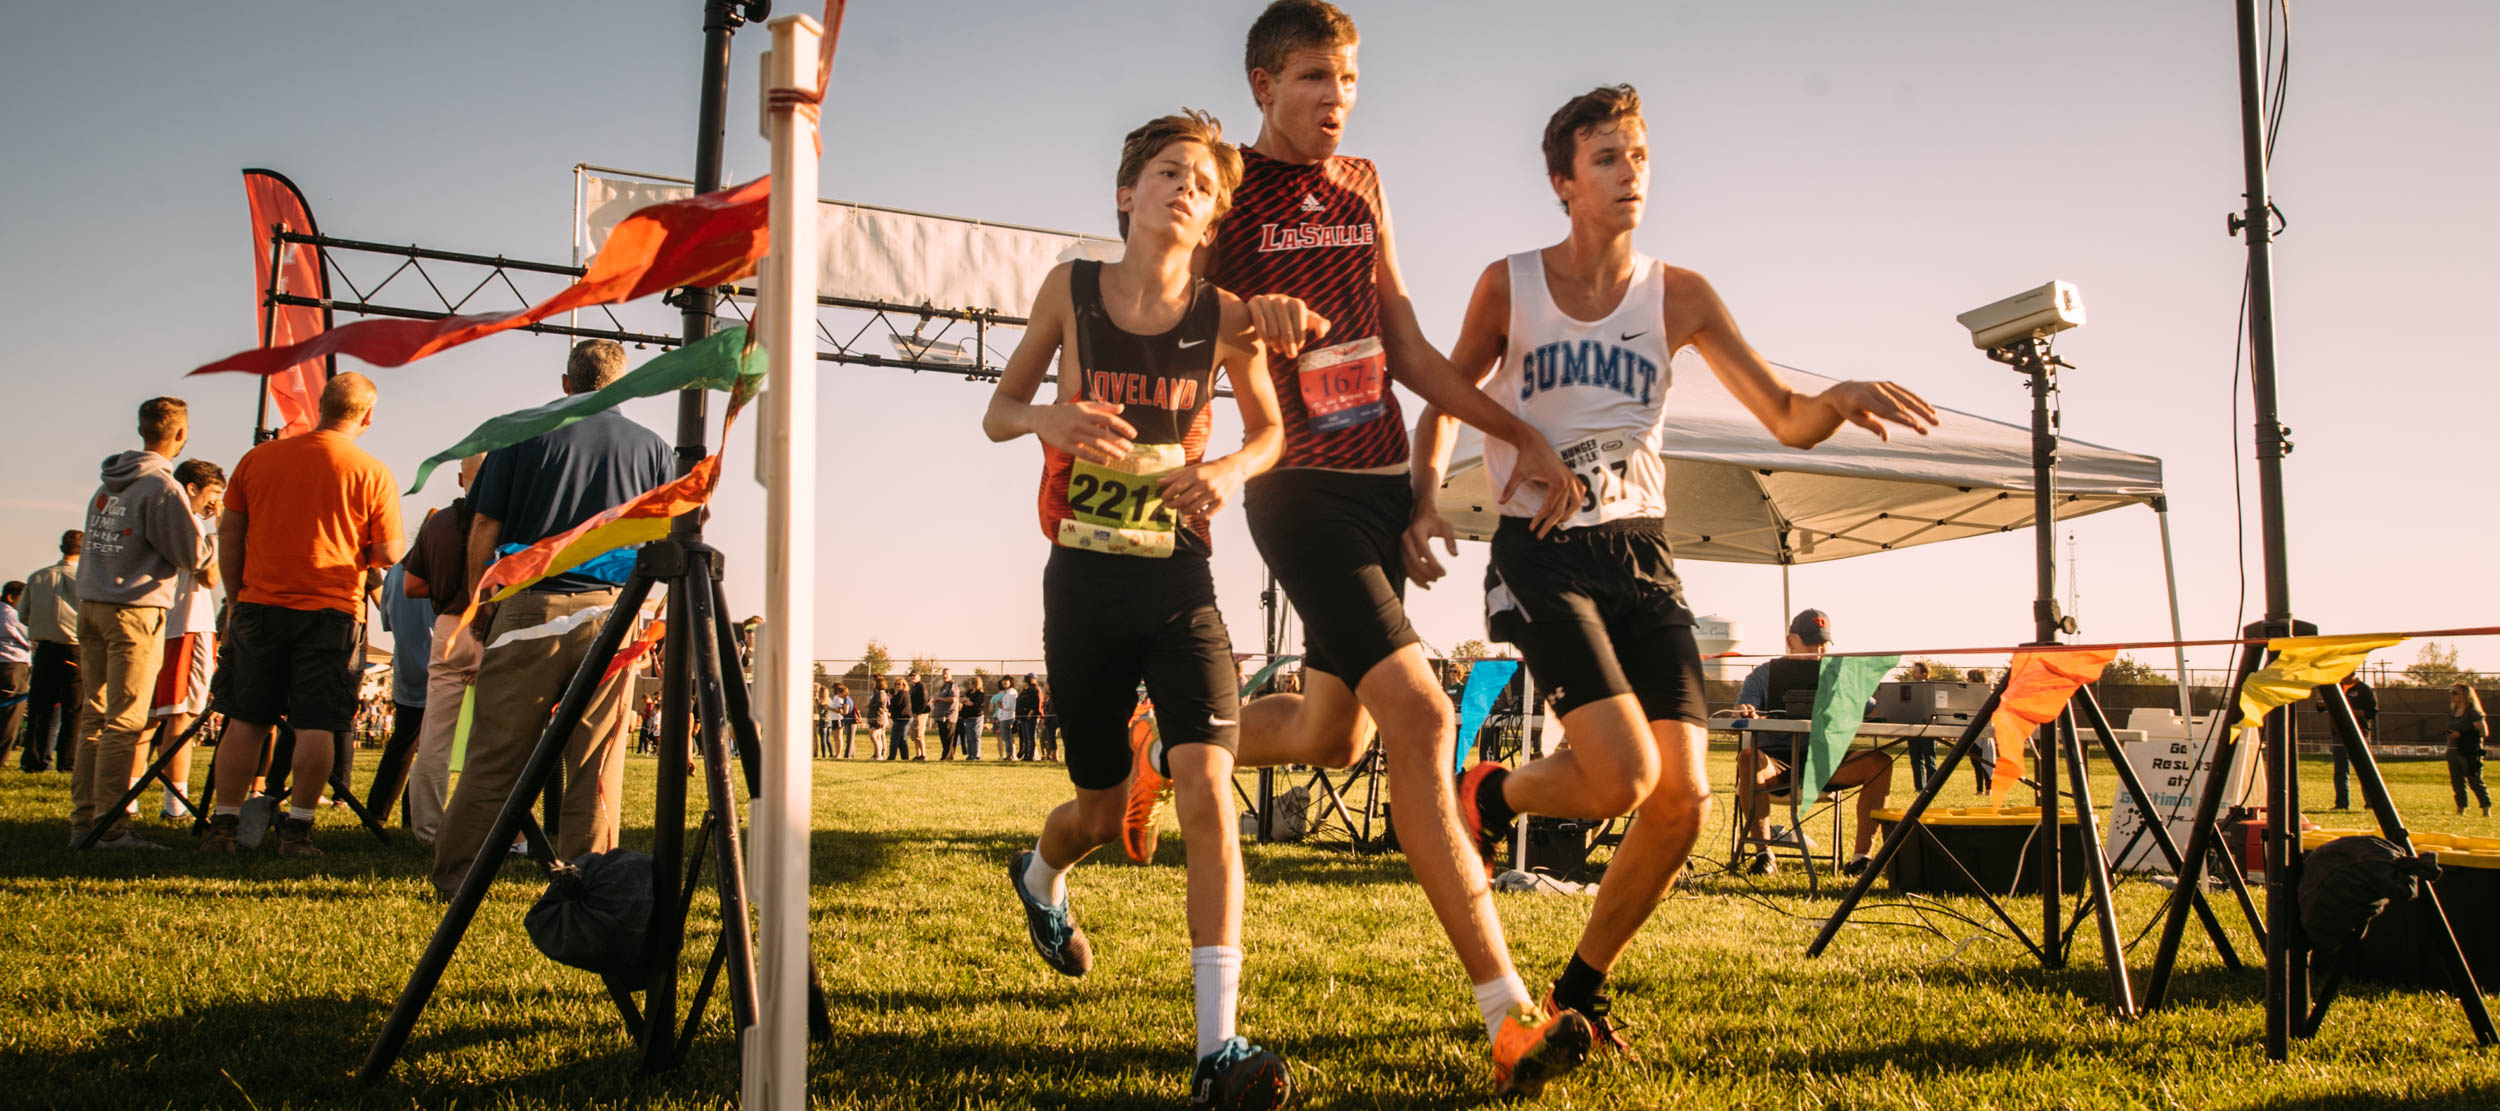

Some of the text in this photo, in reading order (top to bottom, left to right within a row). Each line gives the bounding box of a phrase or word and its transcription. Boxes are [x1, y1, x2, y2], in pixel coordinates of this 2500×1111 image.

[1321, 362, 1379, 397] 1674
[1520, 339, 1658, 408] SUMMIT
[1069, 473, 1173, 523] 2212
